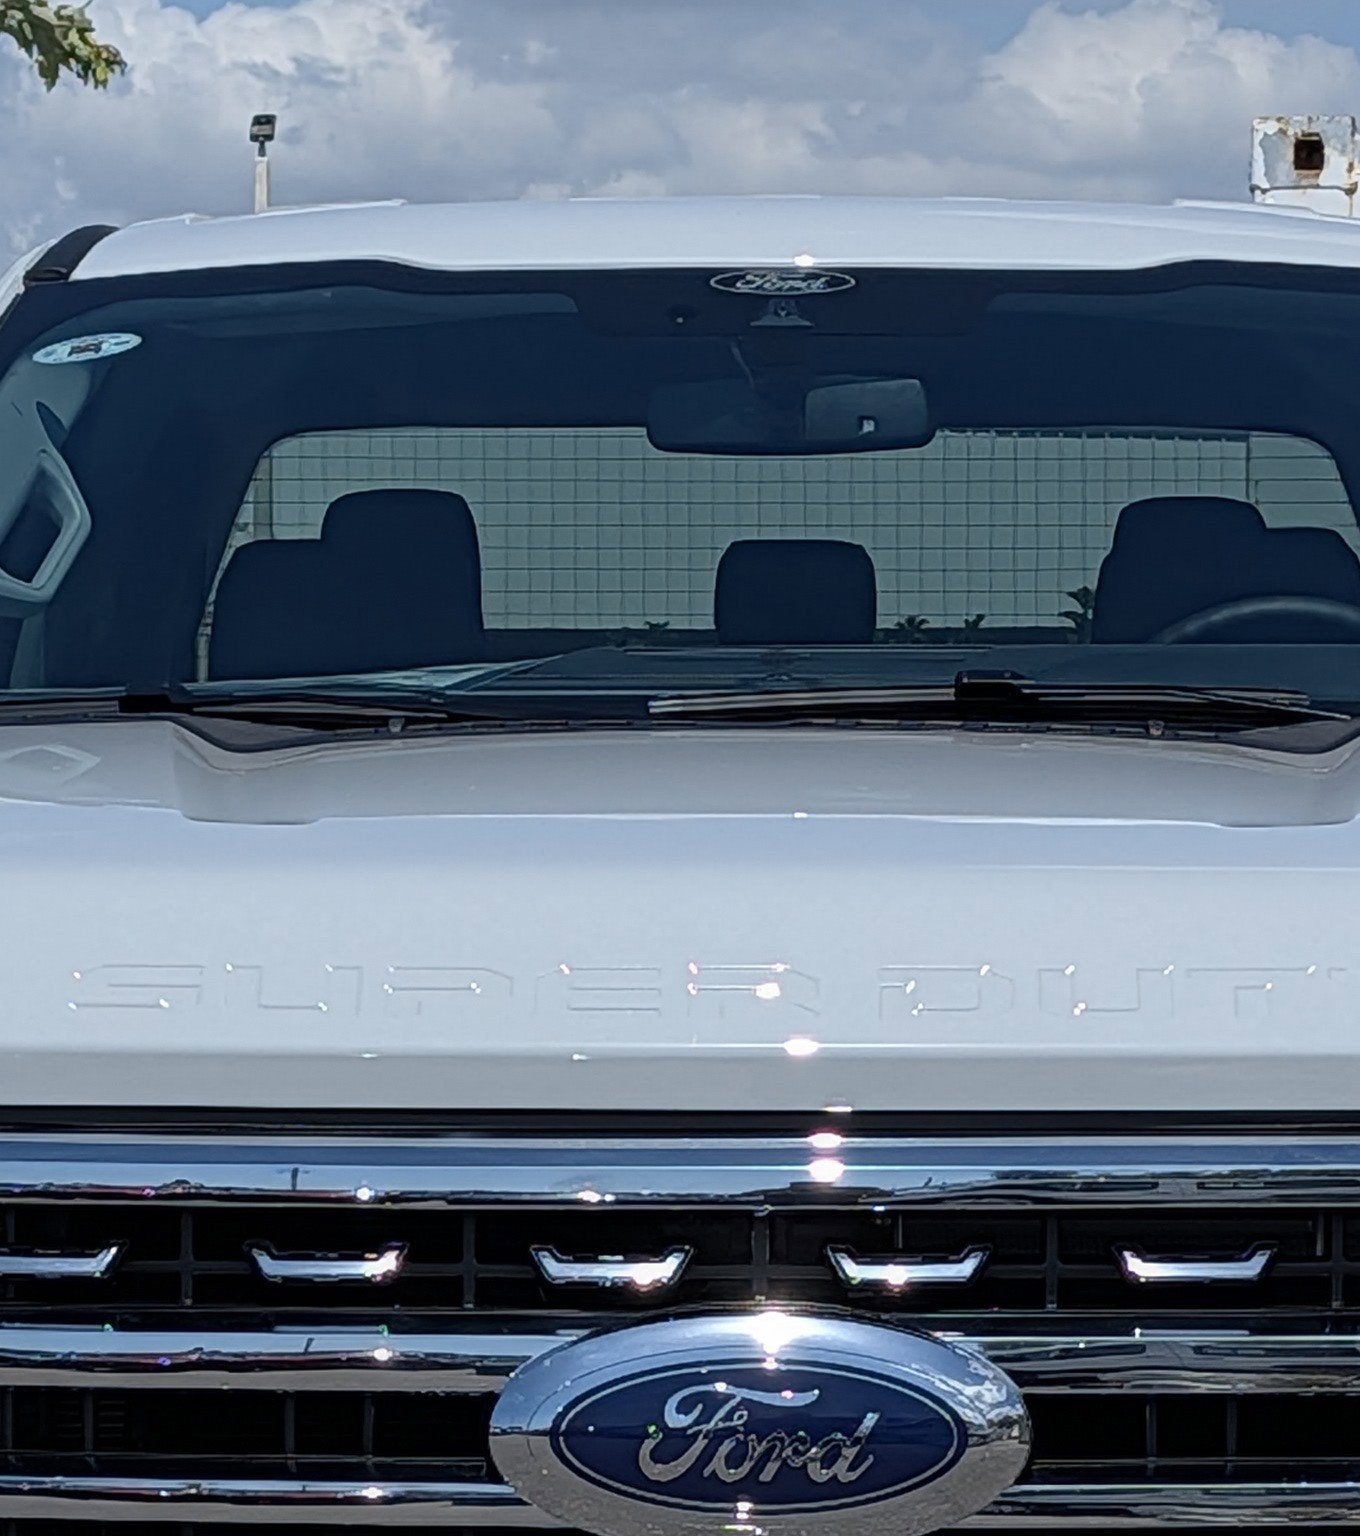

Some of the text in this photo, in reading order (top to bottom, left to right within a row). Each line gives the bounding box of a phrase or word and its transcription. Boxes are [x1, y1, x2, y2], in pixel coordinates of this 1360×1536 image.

[735, 273, 830, 292] Ford
[68, 962, 822, 1018] SUPER
[639, 1382, 880, 1482] Ford
